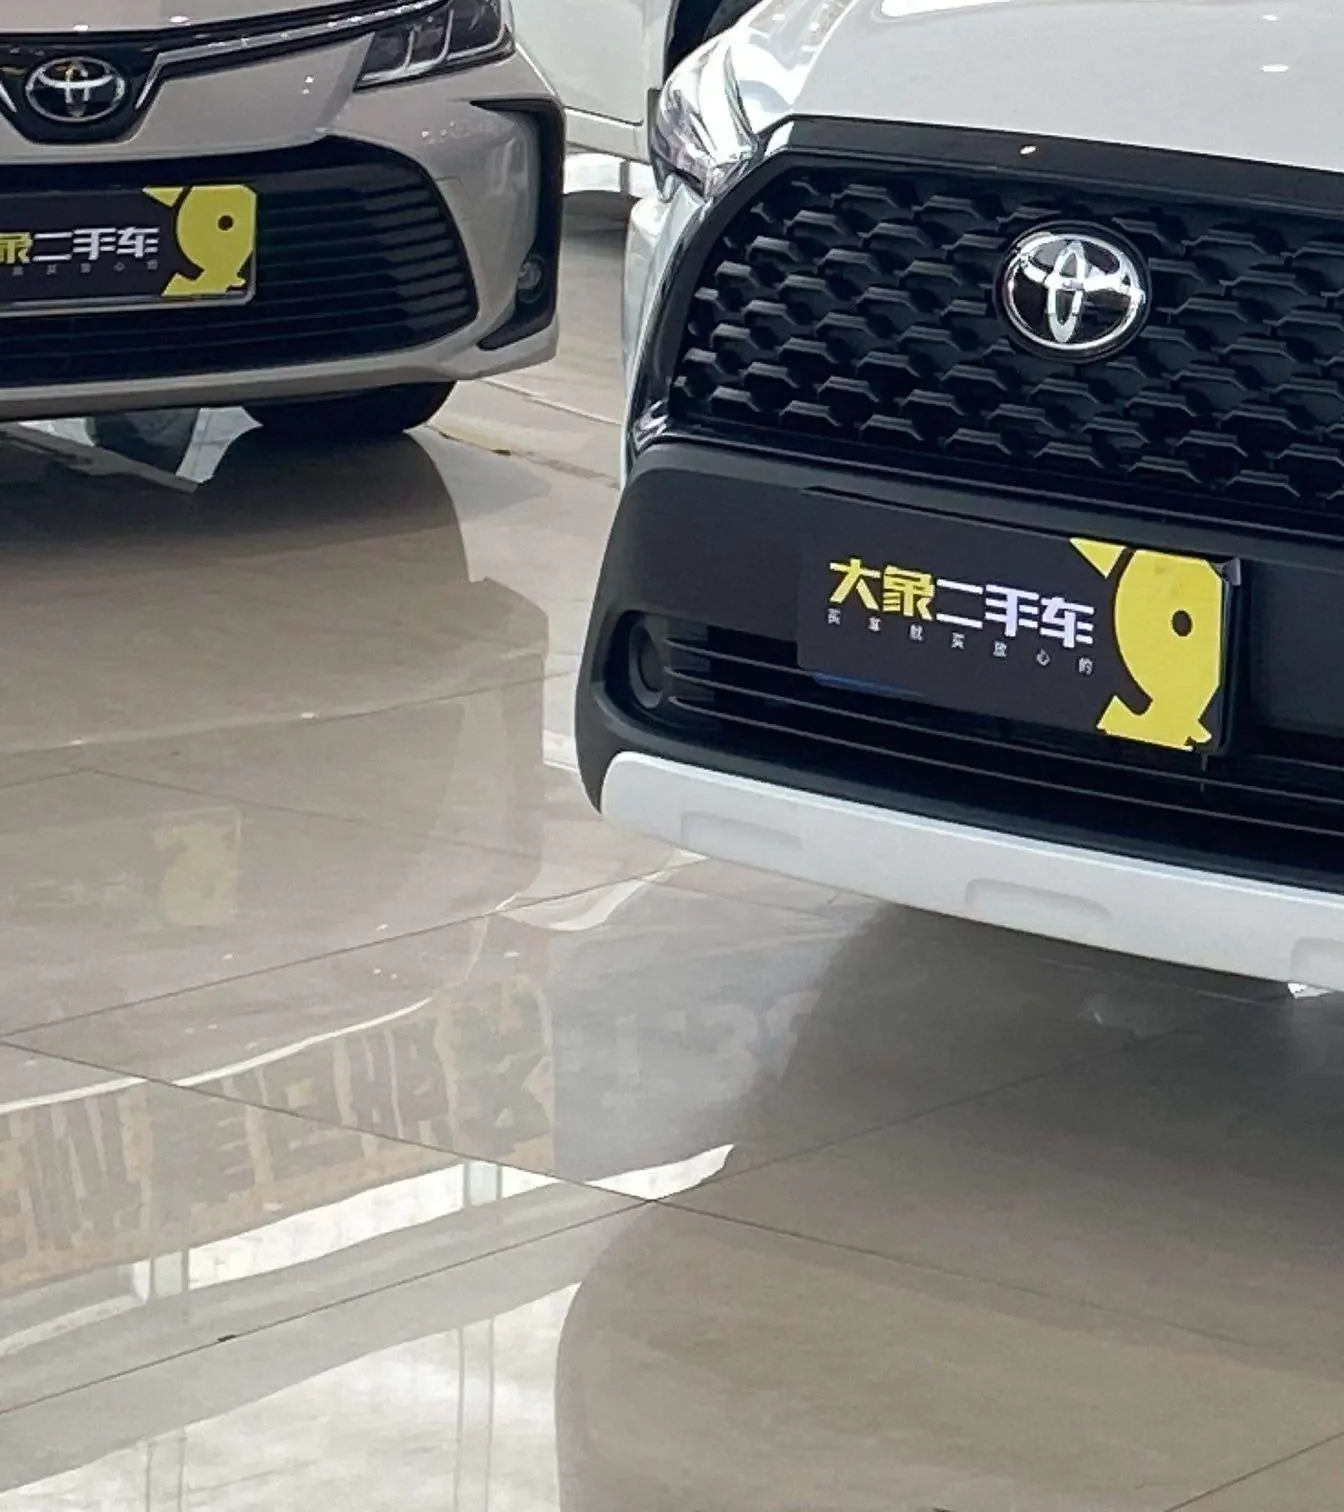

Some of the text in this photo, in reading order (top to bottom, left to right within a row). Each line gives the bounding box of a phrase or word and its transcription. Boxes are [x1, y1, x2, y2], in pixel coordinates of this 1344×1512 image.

[828, 558, 1095, 648] 大象二手车
